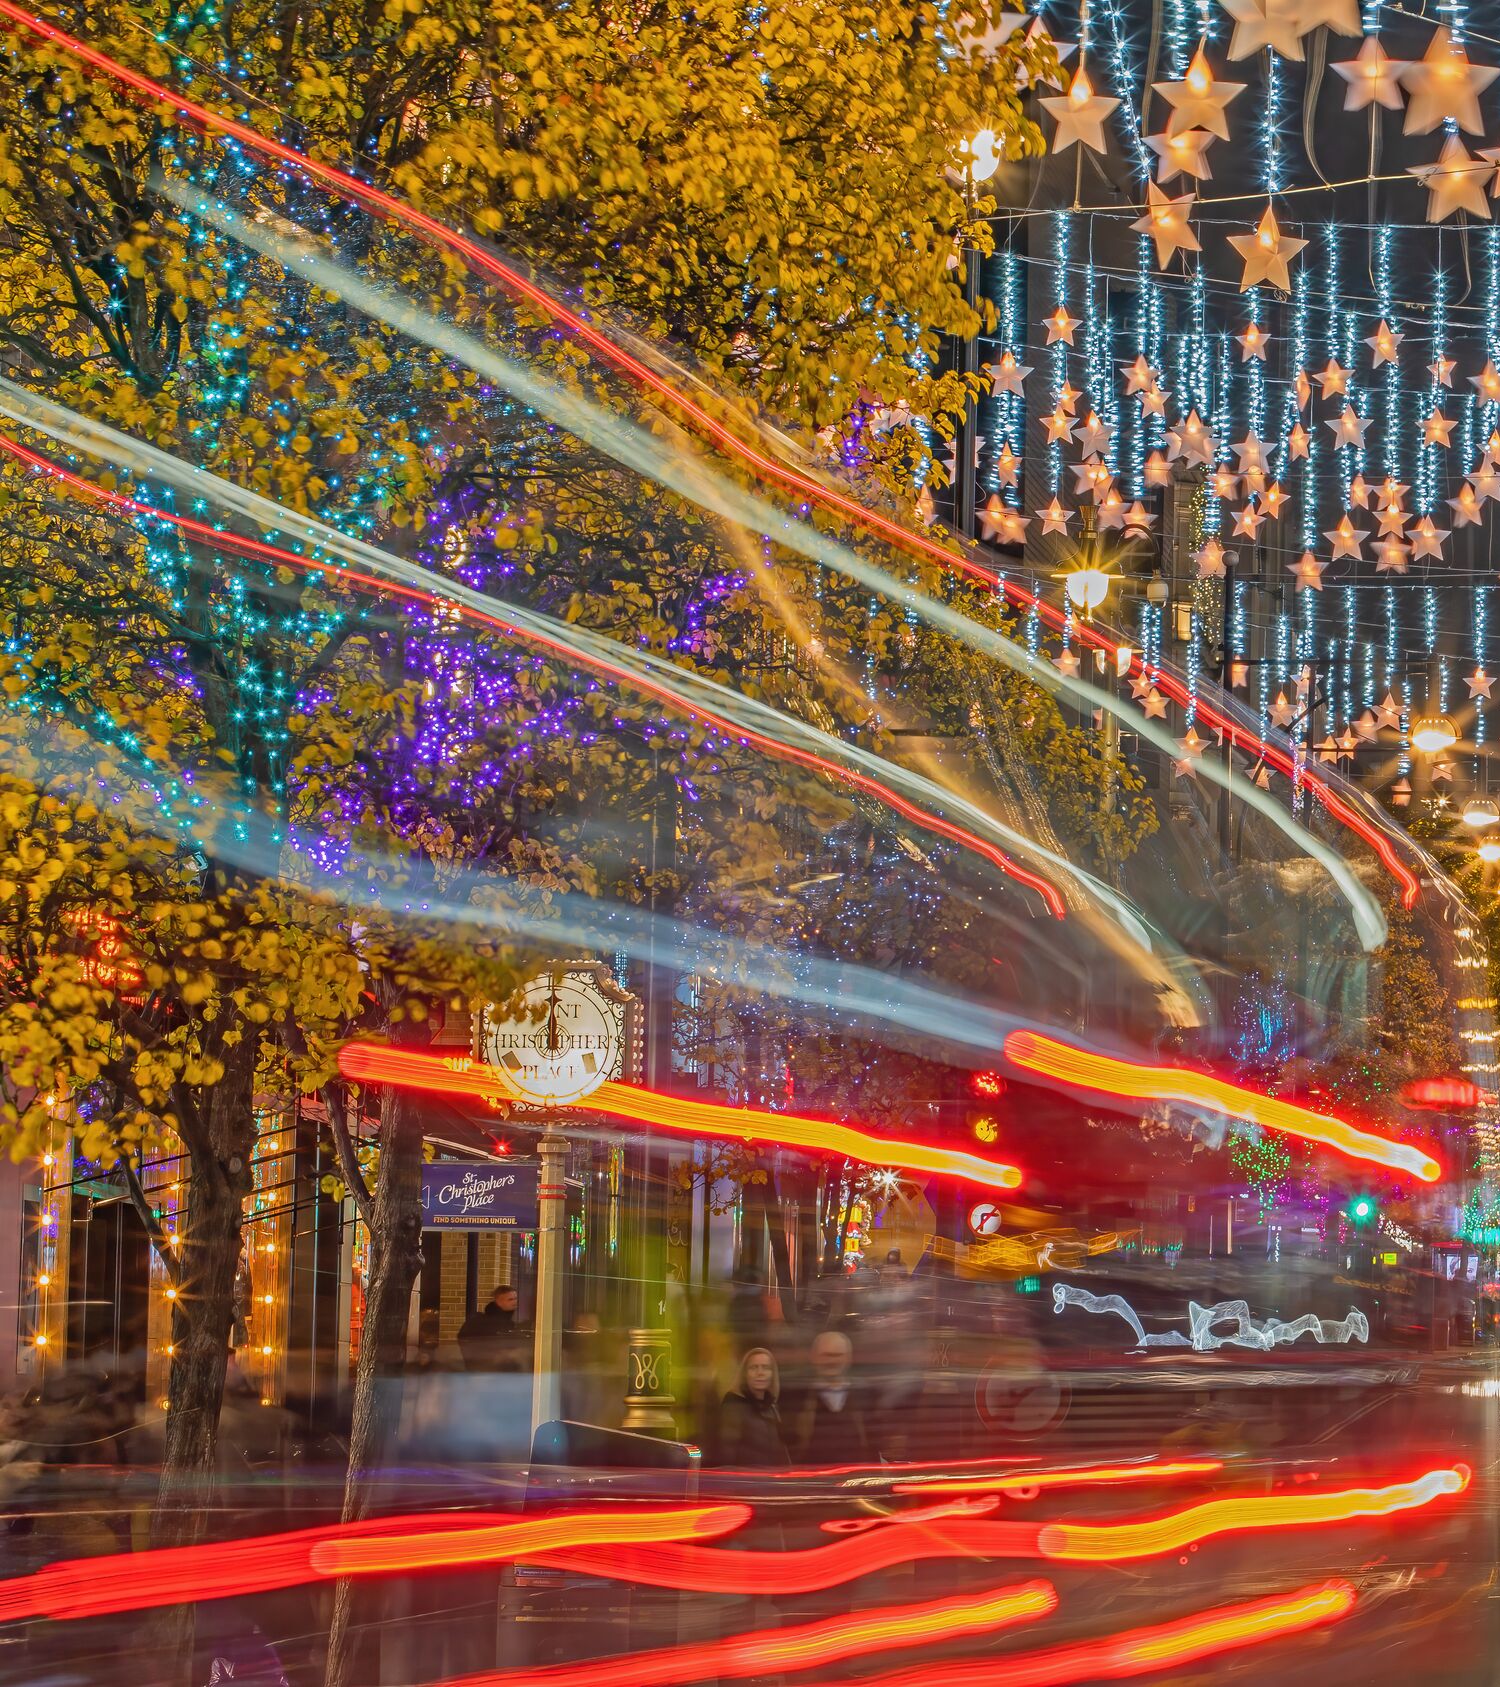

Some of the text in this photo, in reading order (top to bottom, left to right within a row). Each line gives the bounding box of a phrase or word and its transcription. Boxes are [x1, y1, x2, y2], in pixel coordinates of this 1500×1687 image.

[462, 1172, 478, 1185] St
[460, 1193, 495, 1214] Place
[433, 1216, 450, 1224] FIND
[450, 1216, 489, 1225] SOMETHING
